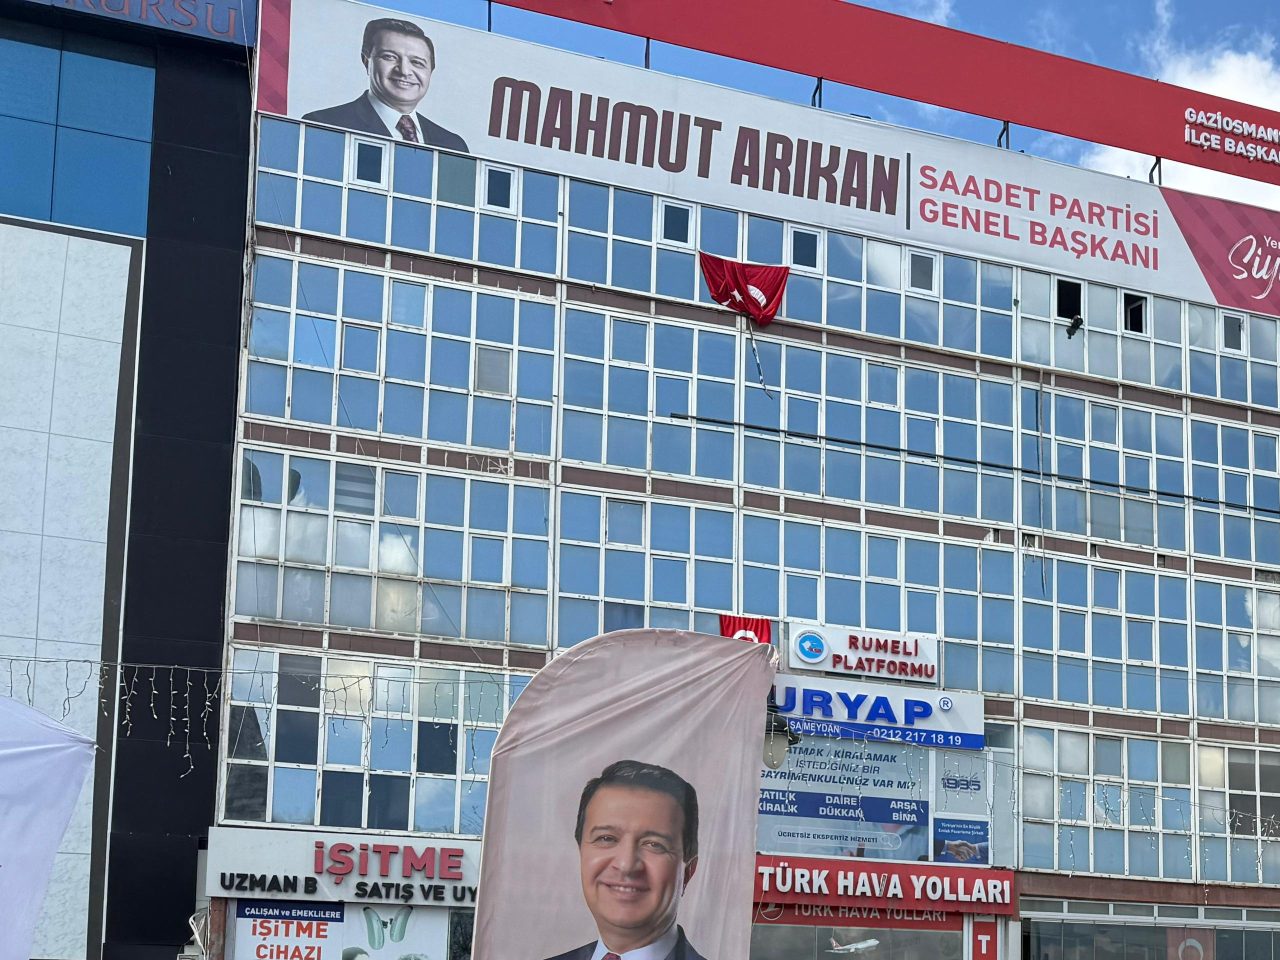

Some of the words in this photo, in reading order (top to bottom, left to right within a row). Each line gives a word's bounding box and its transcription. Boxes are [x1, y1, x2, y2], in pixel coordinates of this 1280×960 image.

[488, 76, 722, 179] MAHMUT
[730, 125, 900, 216] ARIKAN
[1184, 124, 1222, 152] İLÇE
[919, 165, 1041, 213] SAADET
[1049, 193, 1159, 239] PARTİSİ
[919, 198, 1020, 242] GENEL
[1029, 220, 1159, 271] BAŞKANI
[848, 634, 919, 657] RUMELİ
[832, 653, 936, 679] PLATFORMU
[873, 728, 901, 741] 0212
[906, 731, 926, 743] 217
[931, 732, 944, 744] 18
[948, 734, 962, 746] 19
[872, 778, 893, 789] VAR
[314, 840, 465, 885] İŞİTME
[220, 872, 298, 894] UZMAN
[354, 881, 414, 903] SATIŞ
[419, 884, 446, 901] VE
[758, 862, 829, 896] TÜRK
[837, 870, 904, 900] HAVA
[910, 875, 1011, 904] YOLLARI
[245, 907, 280, 916] ÇALIŞAN
[838, 906, 881, 920] HAVA
[885, 908, 947, 922] YOLLARI
[251, 918, 329, 941] İŞİTME
[255, 944, 322, 960] CİHAZI
